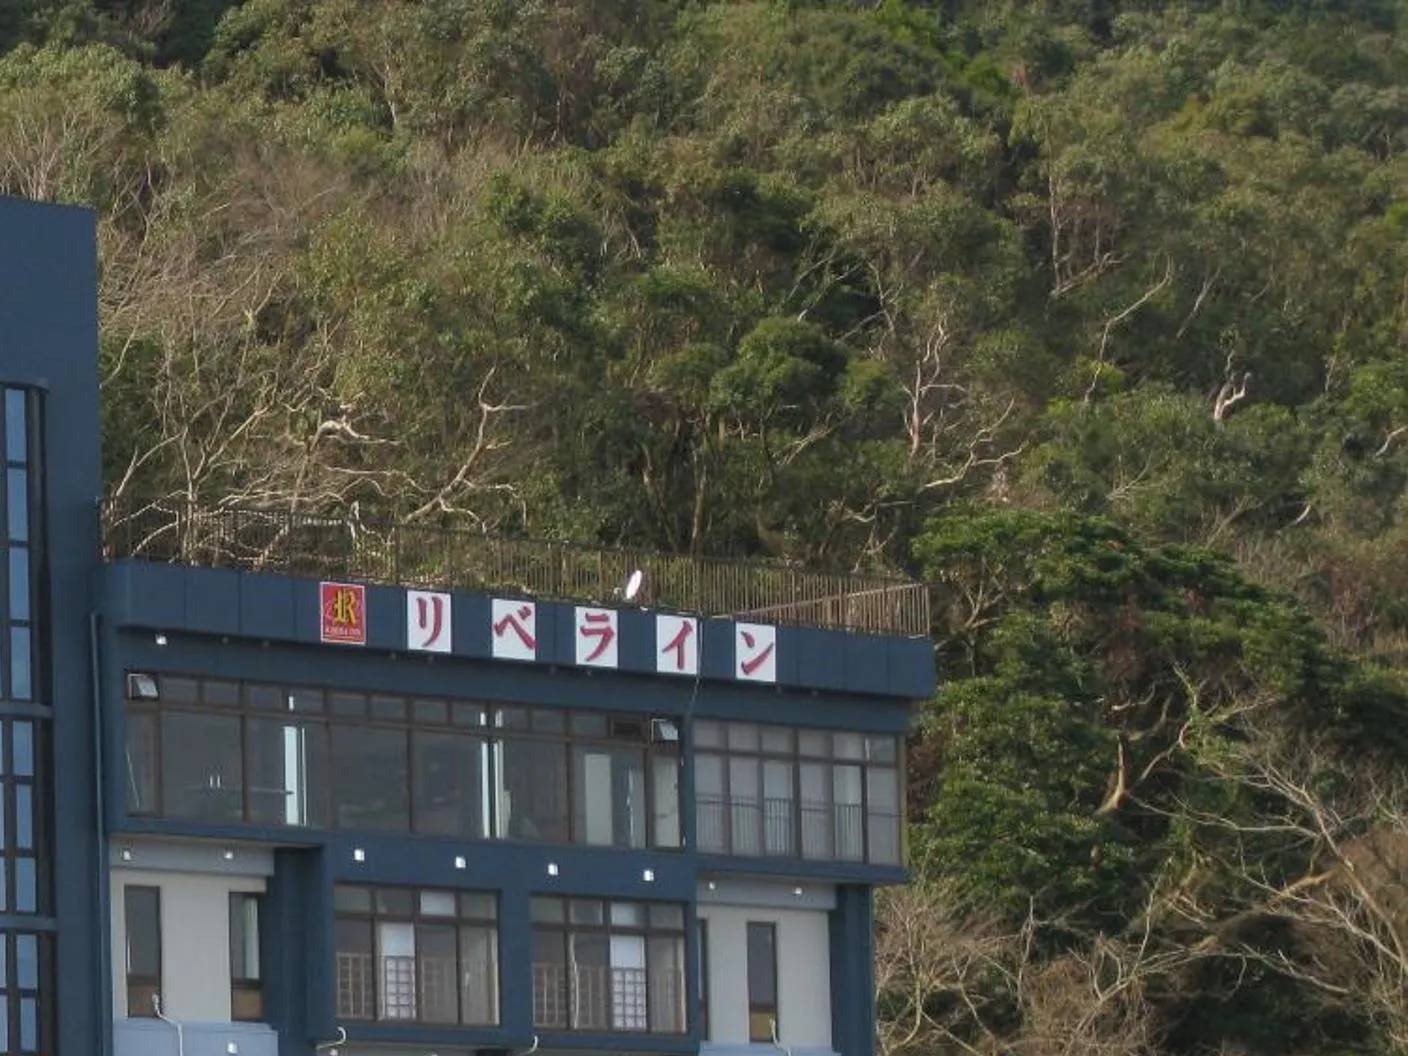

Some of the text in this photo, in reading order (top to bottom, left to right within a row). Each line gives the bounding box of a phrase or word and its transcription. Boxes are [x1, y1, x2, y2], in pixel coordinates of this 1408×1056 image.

[416, 596, 775, 676] リベライン
